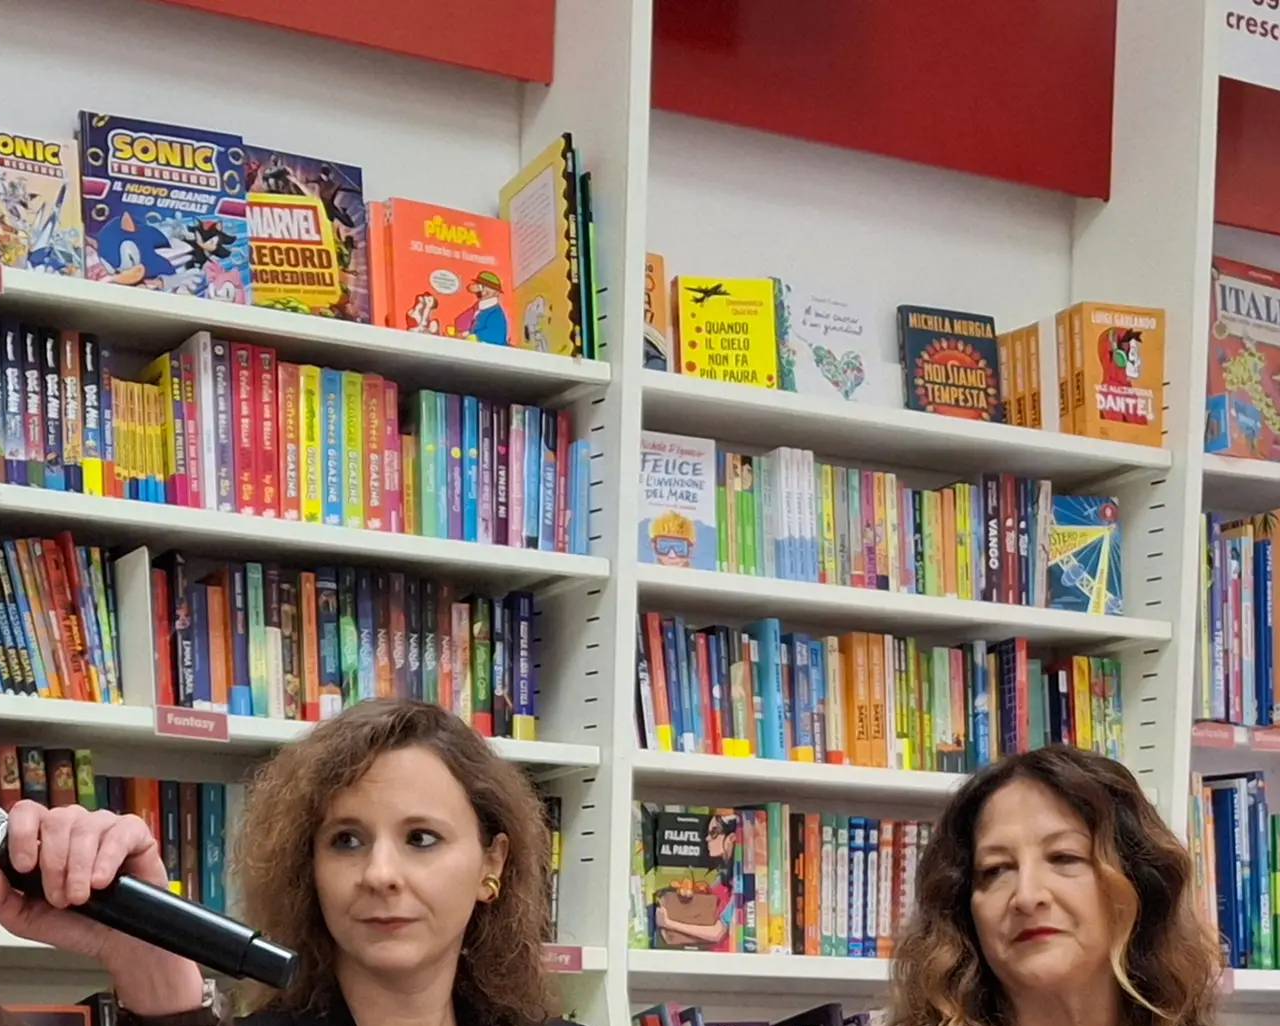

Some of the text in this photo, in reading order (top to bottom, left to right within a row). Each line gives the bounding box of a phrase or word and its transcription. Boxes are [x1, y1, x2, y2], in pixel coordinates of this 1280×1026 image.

[112, 134, 215, 173] SONIC
[122, 194, 210, 214] LIBRO UFFICIALE
[125, 183, 168, 198] NUOVO
[169, 188, 218, 205] GRANDE
[246, 205, 321, 242] MARVEL
[423, 214, 481, 248] PIMPA
[704, 321, 749, 336] QUANDO
[908, 313, 994, 339] MICHELA MURGIA
[704, 337, 750, 352] IL CIELO
[707, 353, 749, 367] NON FA
[722, 369, 758, 384] PAURA
[924, 360, 986, 389] NOI SIAMO
[926, 383, 989, 410] TEMPESTA
[1094, 393, 1155, 421] DANTE!
[639, 451, 705, 478] FELICE
[644, 488, 699, 504] DEL MARE
[987, 518, 1000, 570] VANGO
[166, 713, 216, 734] Fantasy
